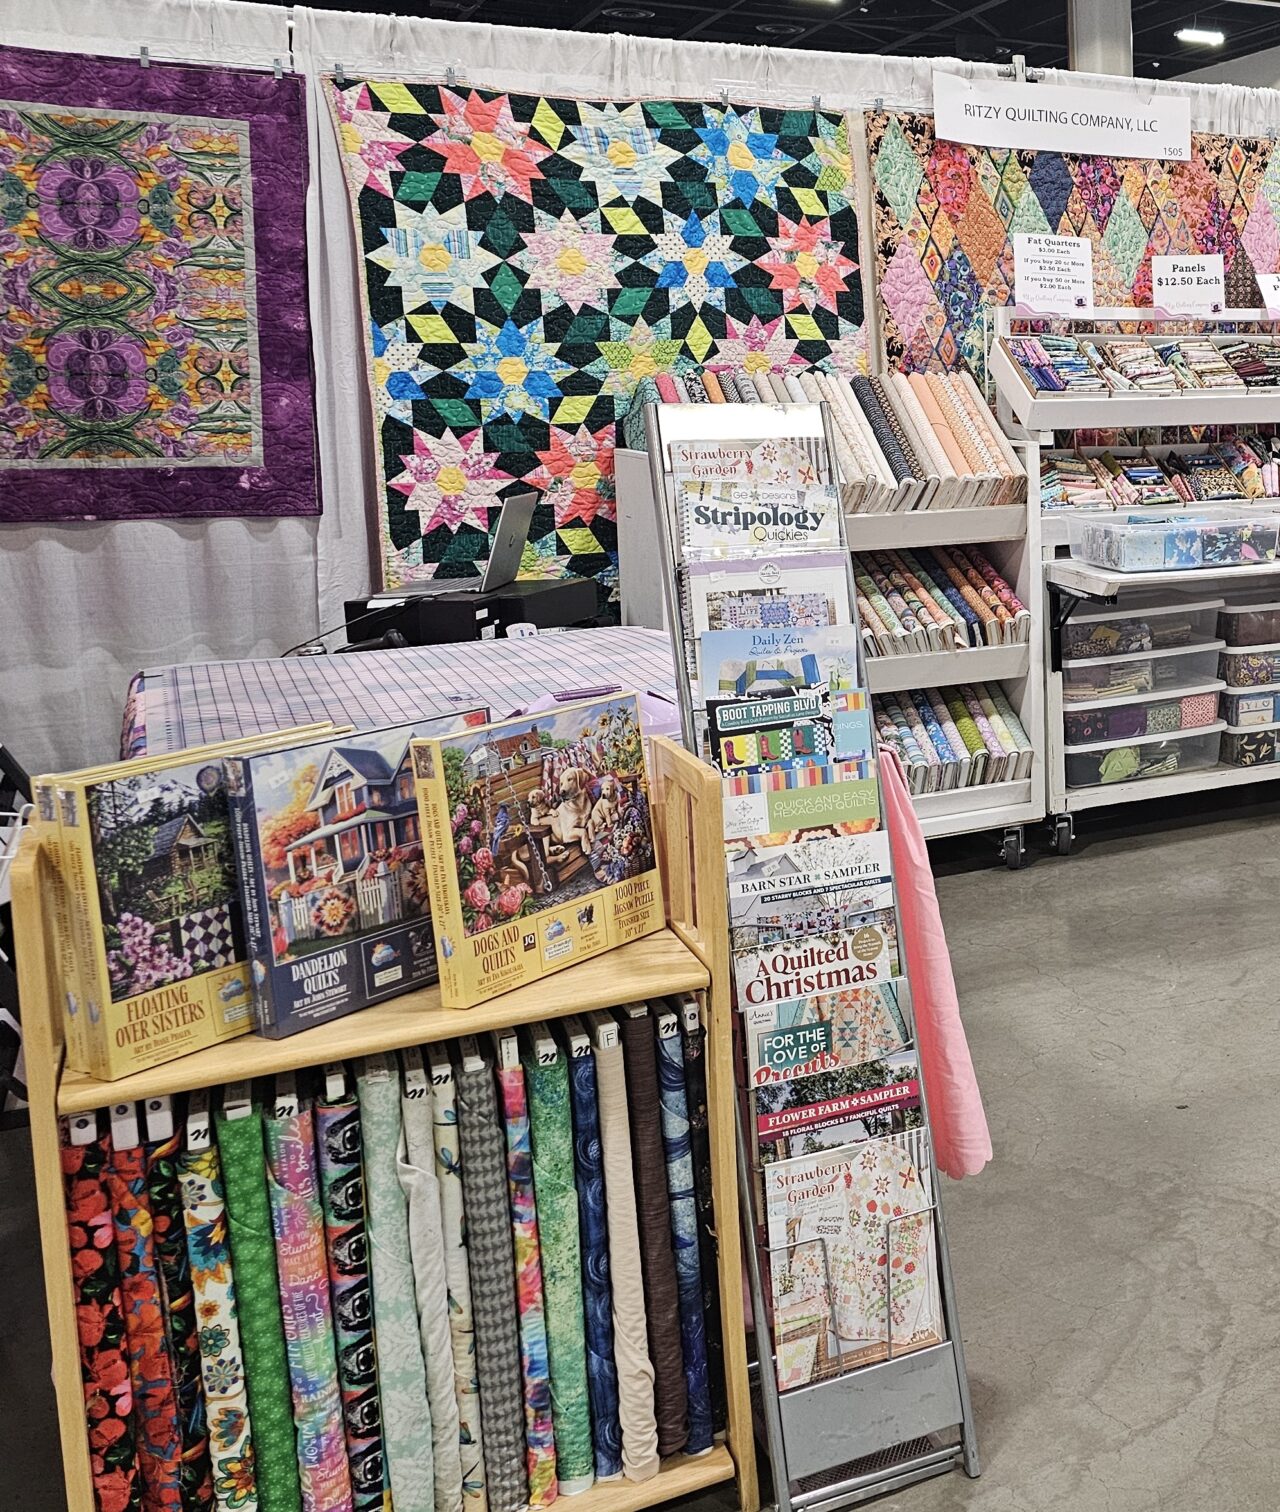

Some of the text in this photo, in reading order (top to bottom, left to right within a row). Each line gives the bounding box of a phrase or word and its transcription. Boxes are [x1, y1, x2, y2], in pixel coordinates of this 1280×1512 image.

[965, 104, 1158, 132] RITZY QUILTING COMPANY, LLC
[1163, 148, 1182, 156] 1505
[1045, 239, 1080, 247] Quarters
[1172, 264, 1206, 272] Panels
[1157, 276, 1220, 286] $12.50 Each
[682, 448, 753, 462] Strawberry
[692, 464, 737, 478] Garden
[694, 505, 825, 531] Stripology
[754, 526, 808, 542] Quickies
[752, 633, 804, 646] Daily Zen
[722, 698, 817, 721] BOOT TAPPING BLVD
[773, 796, 876, 819] HEXAGON QUILTS
[775, 790, 874, 810] QUICK AND EASY
[615, 880, 650, 900] 1000 PIECE
[741, 863, 880, 894] BARN STAR SAMPLER
[829, 882, 864, 892] SPECTACULAR
[614, 891, 654, 916] JIGSAW PUZZLE
[619, 914, 639, 929] FINISHED
[473, 925, 519, 957] DOGS AND
[291, 949, 348, 982] DANDELION
[482, 946, 516, 974] QUILTS
[757, 960, 770, 978] A
[771, 941, 849, 975] Quilted
[304, 969, 340, 995] QUILTS
[745, 962, 878, 1004] Christmas
[126, 984, 188, 1022] FLOATING
[115, 1020, 150, 1048] OVER
[153, 1000, 206, 1035] SISTERS
[764, 1027, 826, 1051] FOR THE
[764, 1042, 826, 1065] LOVE OF
[754, 1051, 840, 1085] Precuts
[768, 1085, 910, 1127] FLOWER FARM SAMPLER
[790, 1126, 814, 1135] FLORAL
[815, 1120, 839, 1129] BLOCKS
[850, 1110, 877, 1121] FANCIFUL
[878, 1104, 899, 1113] QUILTS
[776, 1162, 852, 1189] Strawberry
[788, 1184, 835, 1206] Garden
